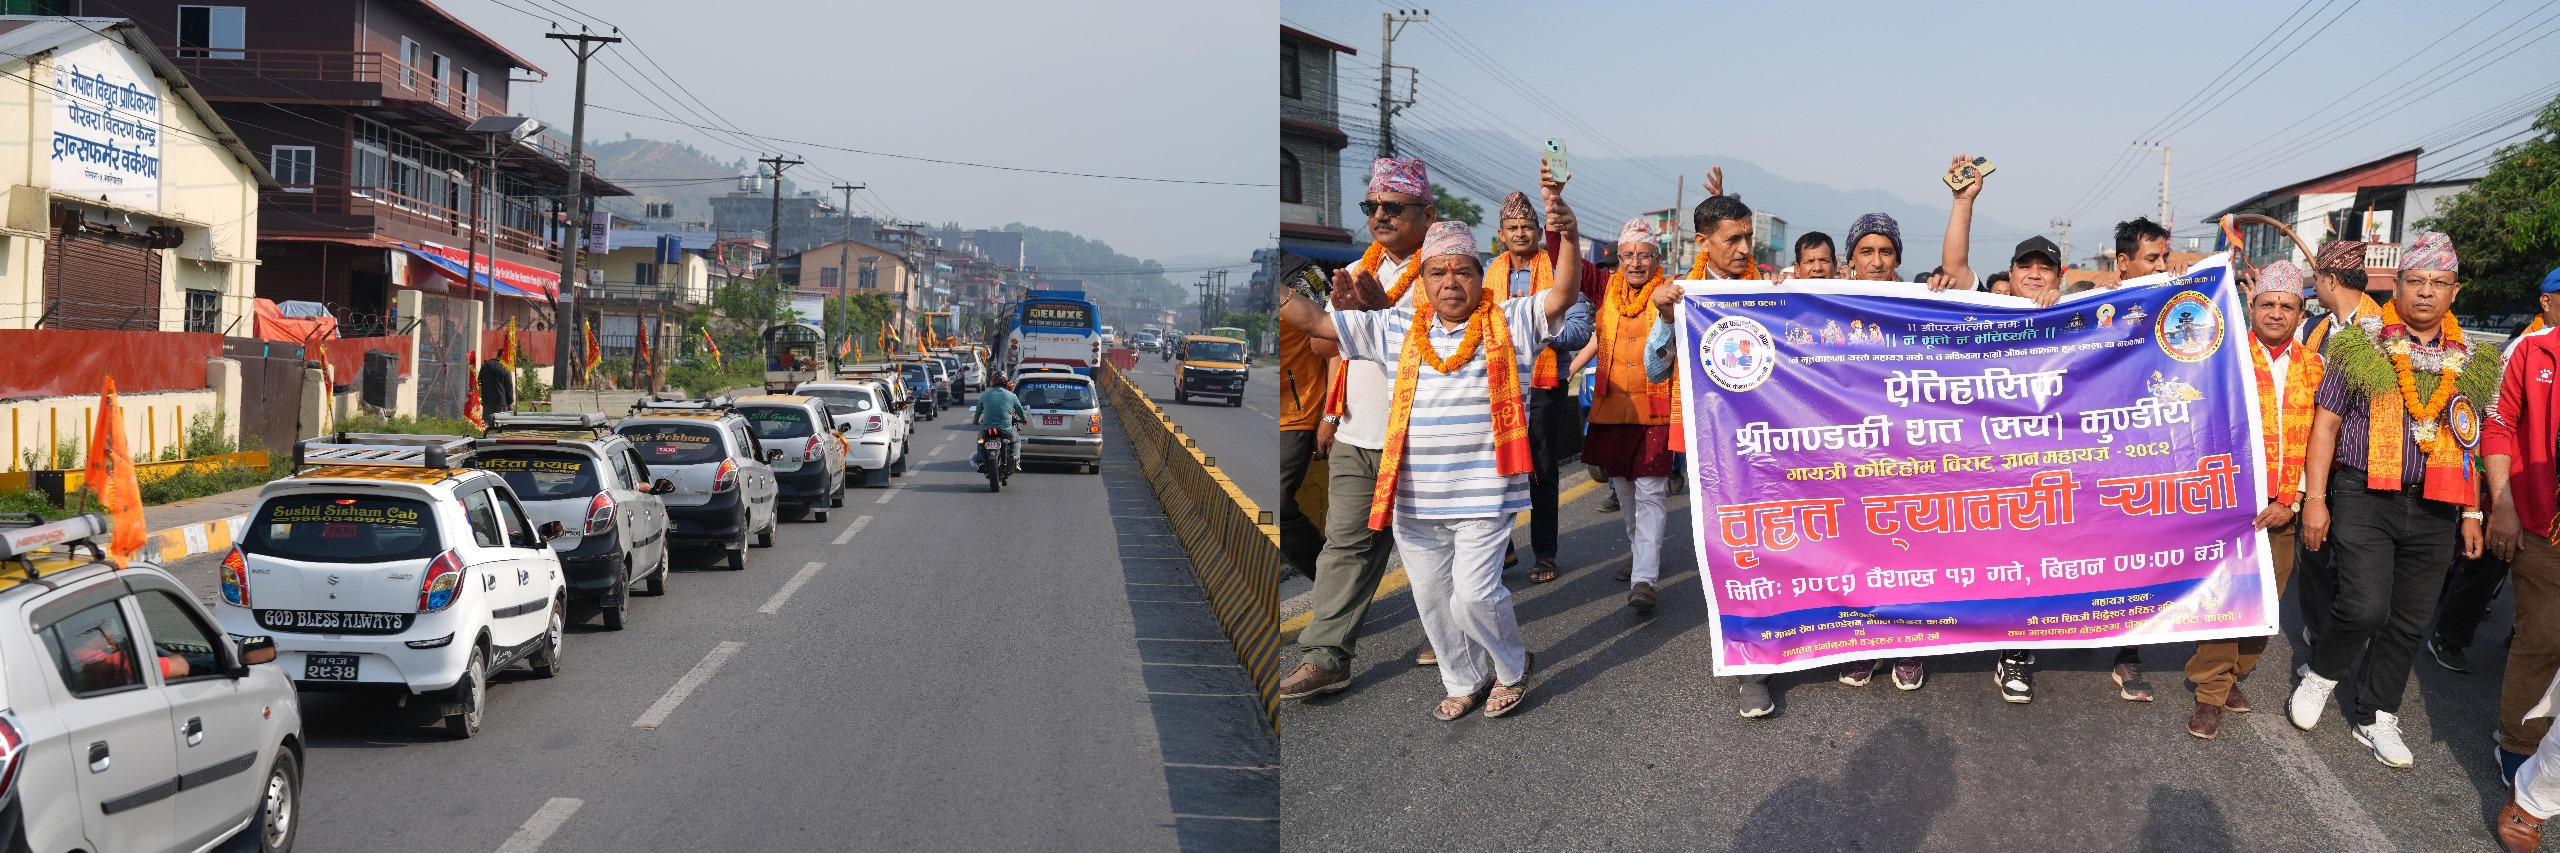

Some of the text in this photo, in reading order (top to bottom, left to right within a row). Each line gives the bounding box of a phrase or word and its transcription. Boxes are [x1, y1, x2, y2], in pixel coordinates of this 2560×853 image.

[72, 64, 93, 98] नेपाल
[95, 74, 119, 112] विद्युत
[120, 82, 157, 116] प्राधिकरण
[68, 100, 156, 147] पोखरा वितरण केन्द्र
[52, 131, 158, 179] ट्रान्सफर्मर वर्कशप
[1030, 308, 1084, 320] DELUXE
[1884, 367, 2068, 409] ऐतिहासिक
[656, 432, 711, 443] Pokhara
[1735, 398, 2192, 456] श्रीगण्डकी शत (सय) कुण्डीय
[1786, 461, 1848, 482] गायत्री
[1853, 457, 1937, 479] कोटिहोम
[2000, 451, 2041, 470] ज्ञान
[2042, 446, 2110, 466] महायज्ञ
[273, 504, 418, 520] Sushil Sisham Cab
[328, 524, 356, 535] TAXI
[1716, 495, 1844, 571] वृहत
[1866, 566, 1938, 588] वैशाख
[2040, 556, 2106, 580] बिहान
[2194, 539, 2227, 562] बजे
[264, 610, 402, 629] GOD BLESS ALWAYS
